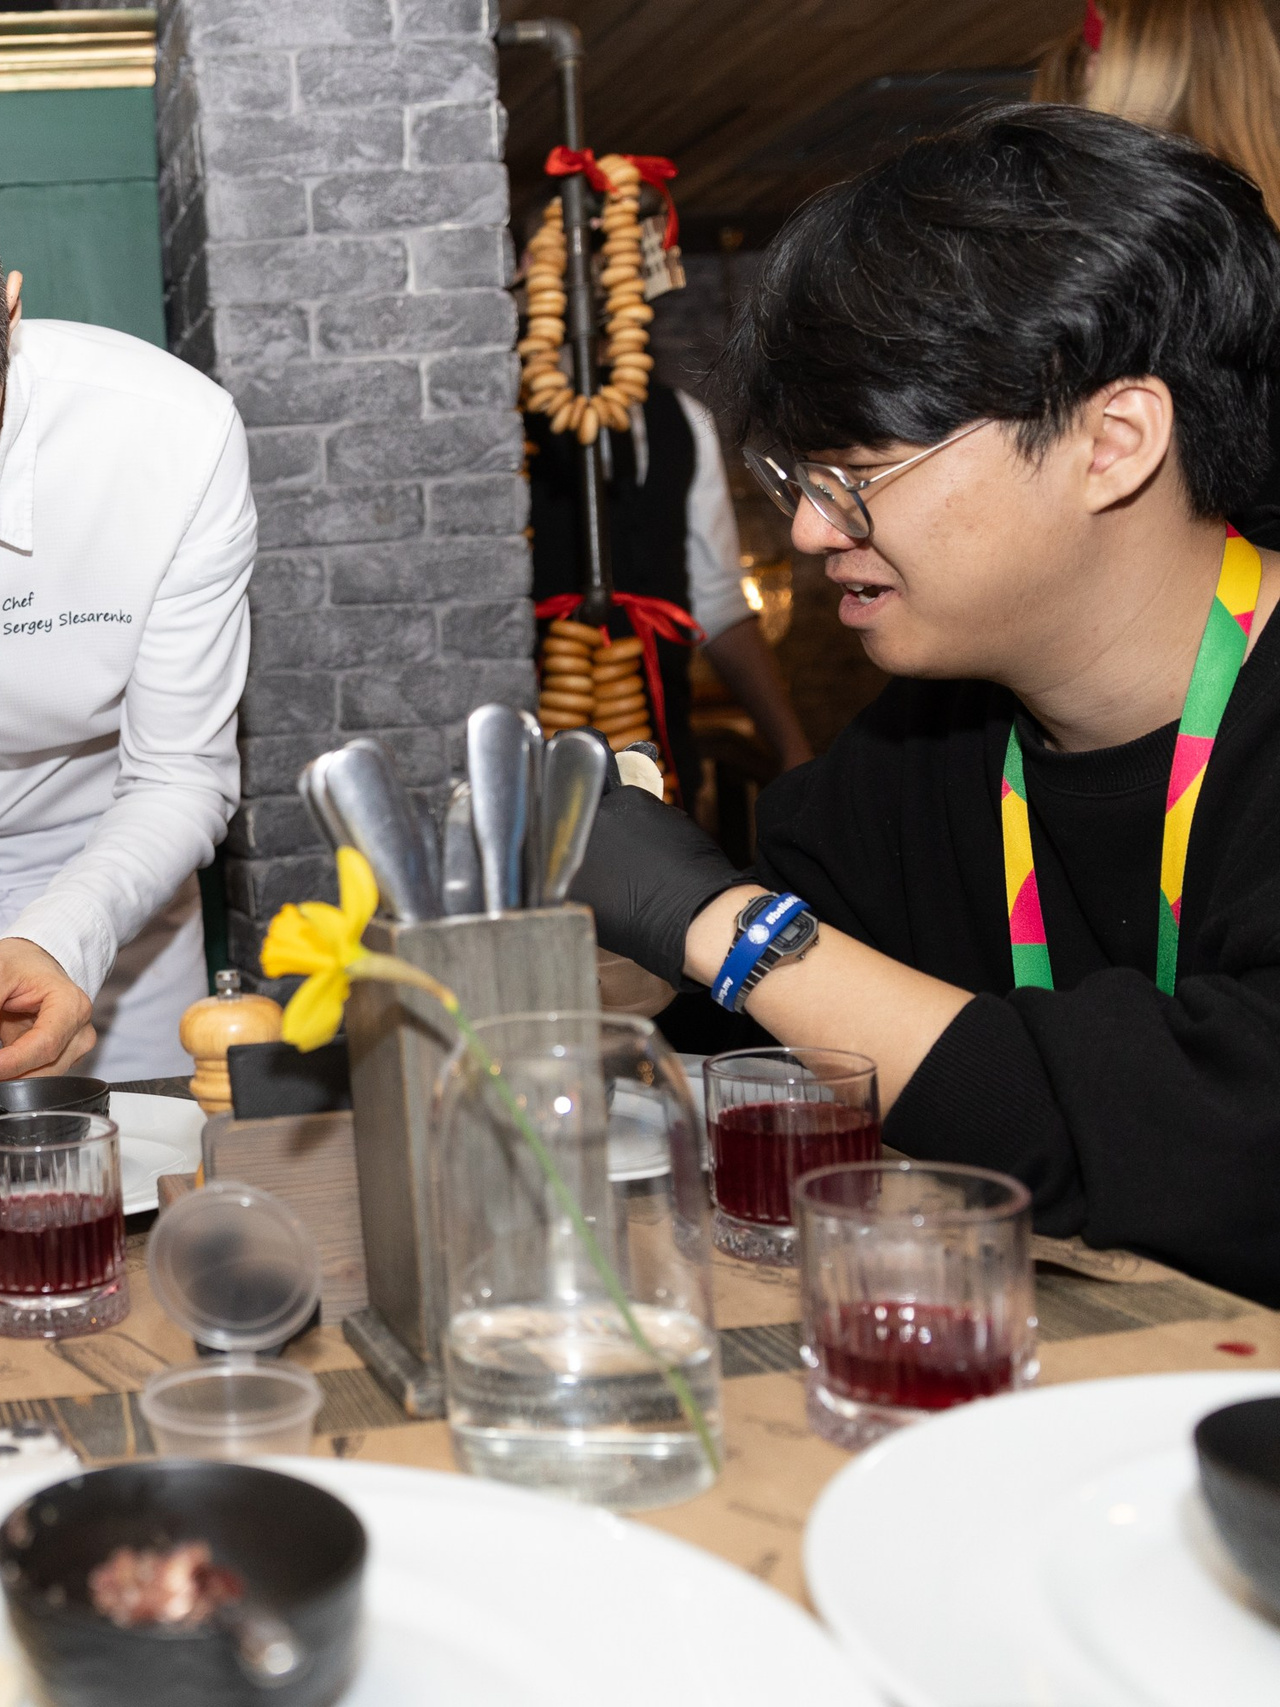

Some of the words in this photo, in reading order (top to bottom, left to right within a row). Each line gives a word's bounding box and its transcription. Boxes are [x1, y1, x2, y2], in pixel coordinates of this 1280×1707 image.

[2, 592, 34, 611] Chef
[3, 617, 53, 635] Sergey
[59, 609, 133, 626] Slesarenko
